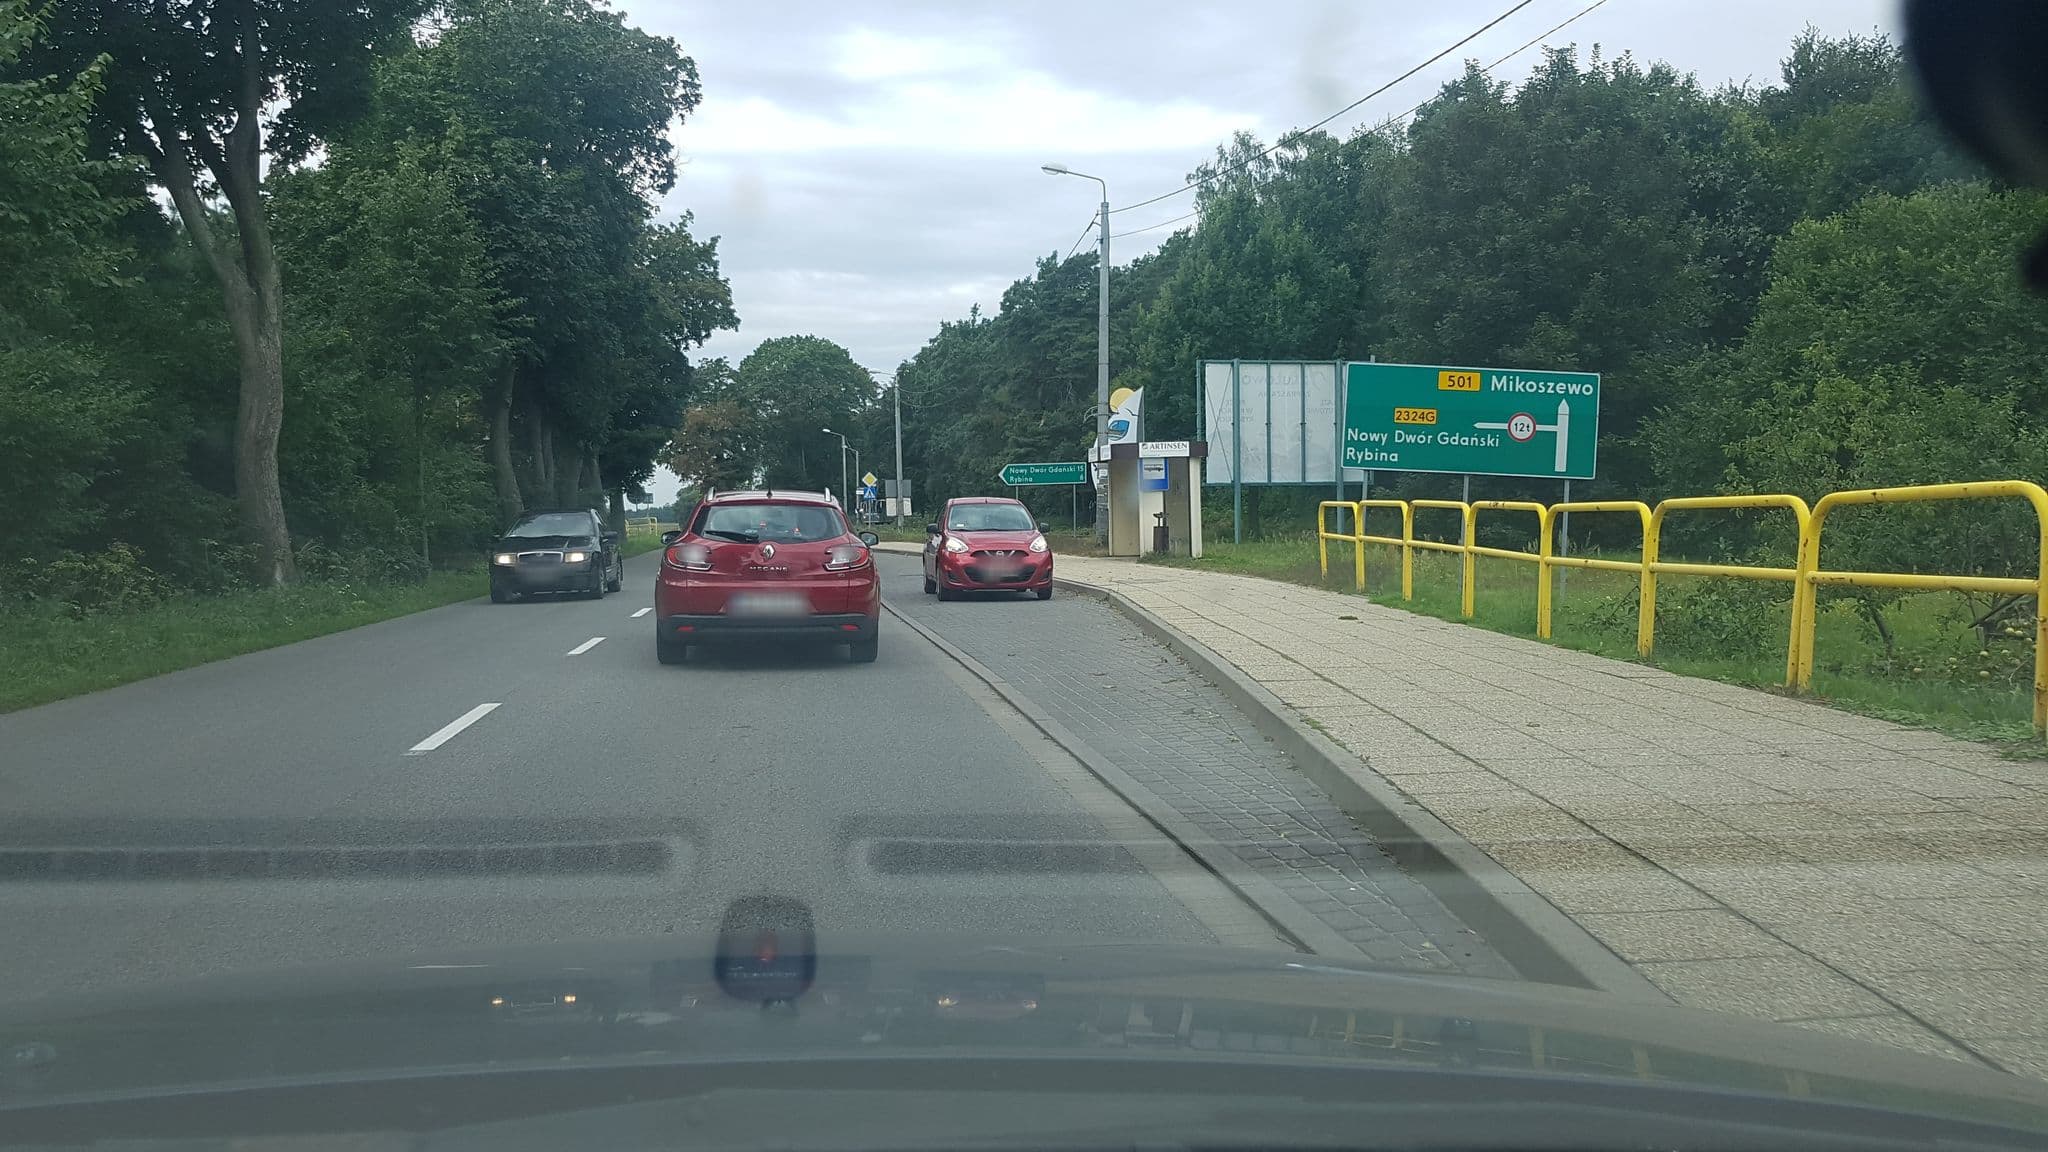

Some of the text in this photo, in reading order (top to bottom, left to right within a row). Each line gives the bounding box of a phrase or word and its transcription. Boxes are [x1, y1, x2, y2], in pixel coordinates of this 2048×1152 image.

[1447, 375, 1594, 396] 501 Mikoszewo
[1395, 410, 1436, 422] 2324G
[1513, 422, 1530, 433] 12t
[1347, 429, 1500, 448] Nowy Dwór Gdański
[1150, 442, 1188, 450] ARTINSEN
[1346, 448, 1399, 465] Rybina
[1009, 467, 1027, 475] Nowy
[1048, 465, 1075, 473] Gdański
